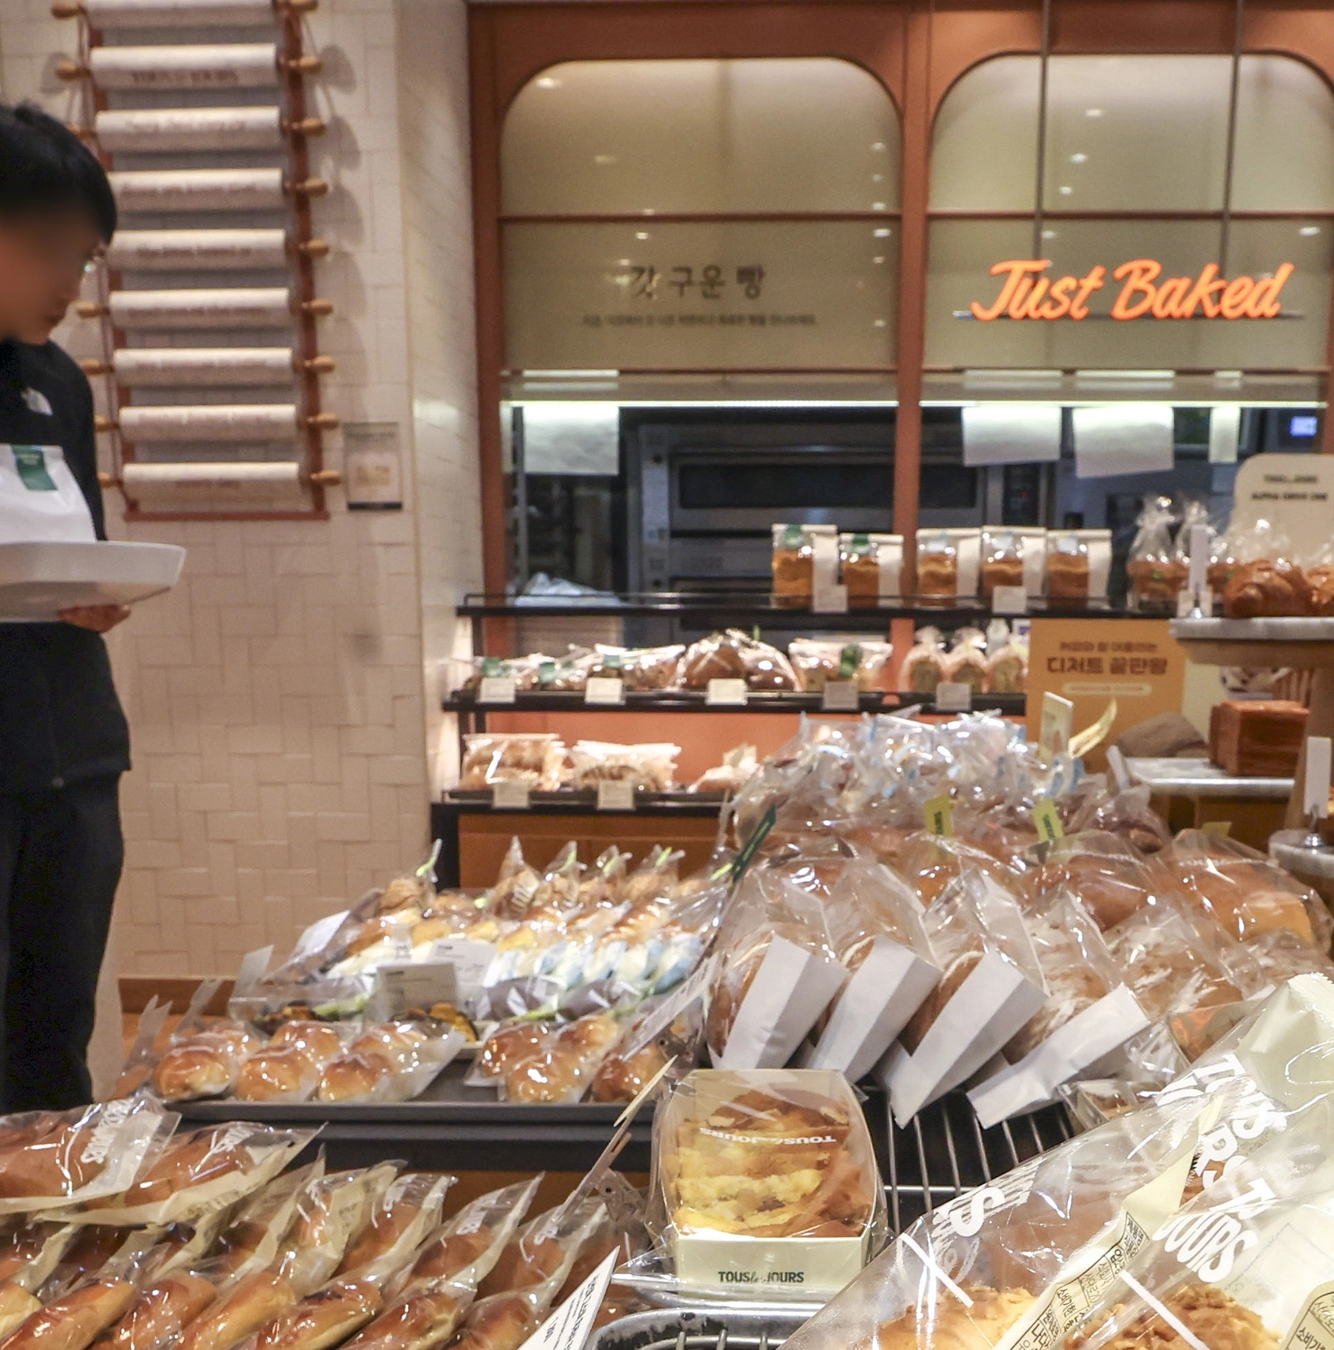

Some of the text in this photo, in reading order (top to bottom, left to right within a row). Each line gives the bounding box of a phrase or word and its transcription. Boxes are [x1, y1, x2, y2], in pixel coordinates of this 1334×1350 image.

[669, 264, 725, 299] 구운
[736, 264, 764, 299] 빵
[970, 259, 1294, 320] Just Baked
[1047, 657, 1103, 674] 디저트
[784, 1135, 837, 1145] TOUS
[718, 1272, 751, 1283] TOUS
[767, 1272, 805, 1284] JOURS
